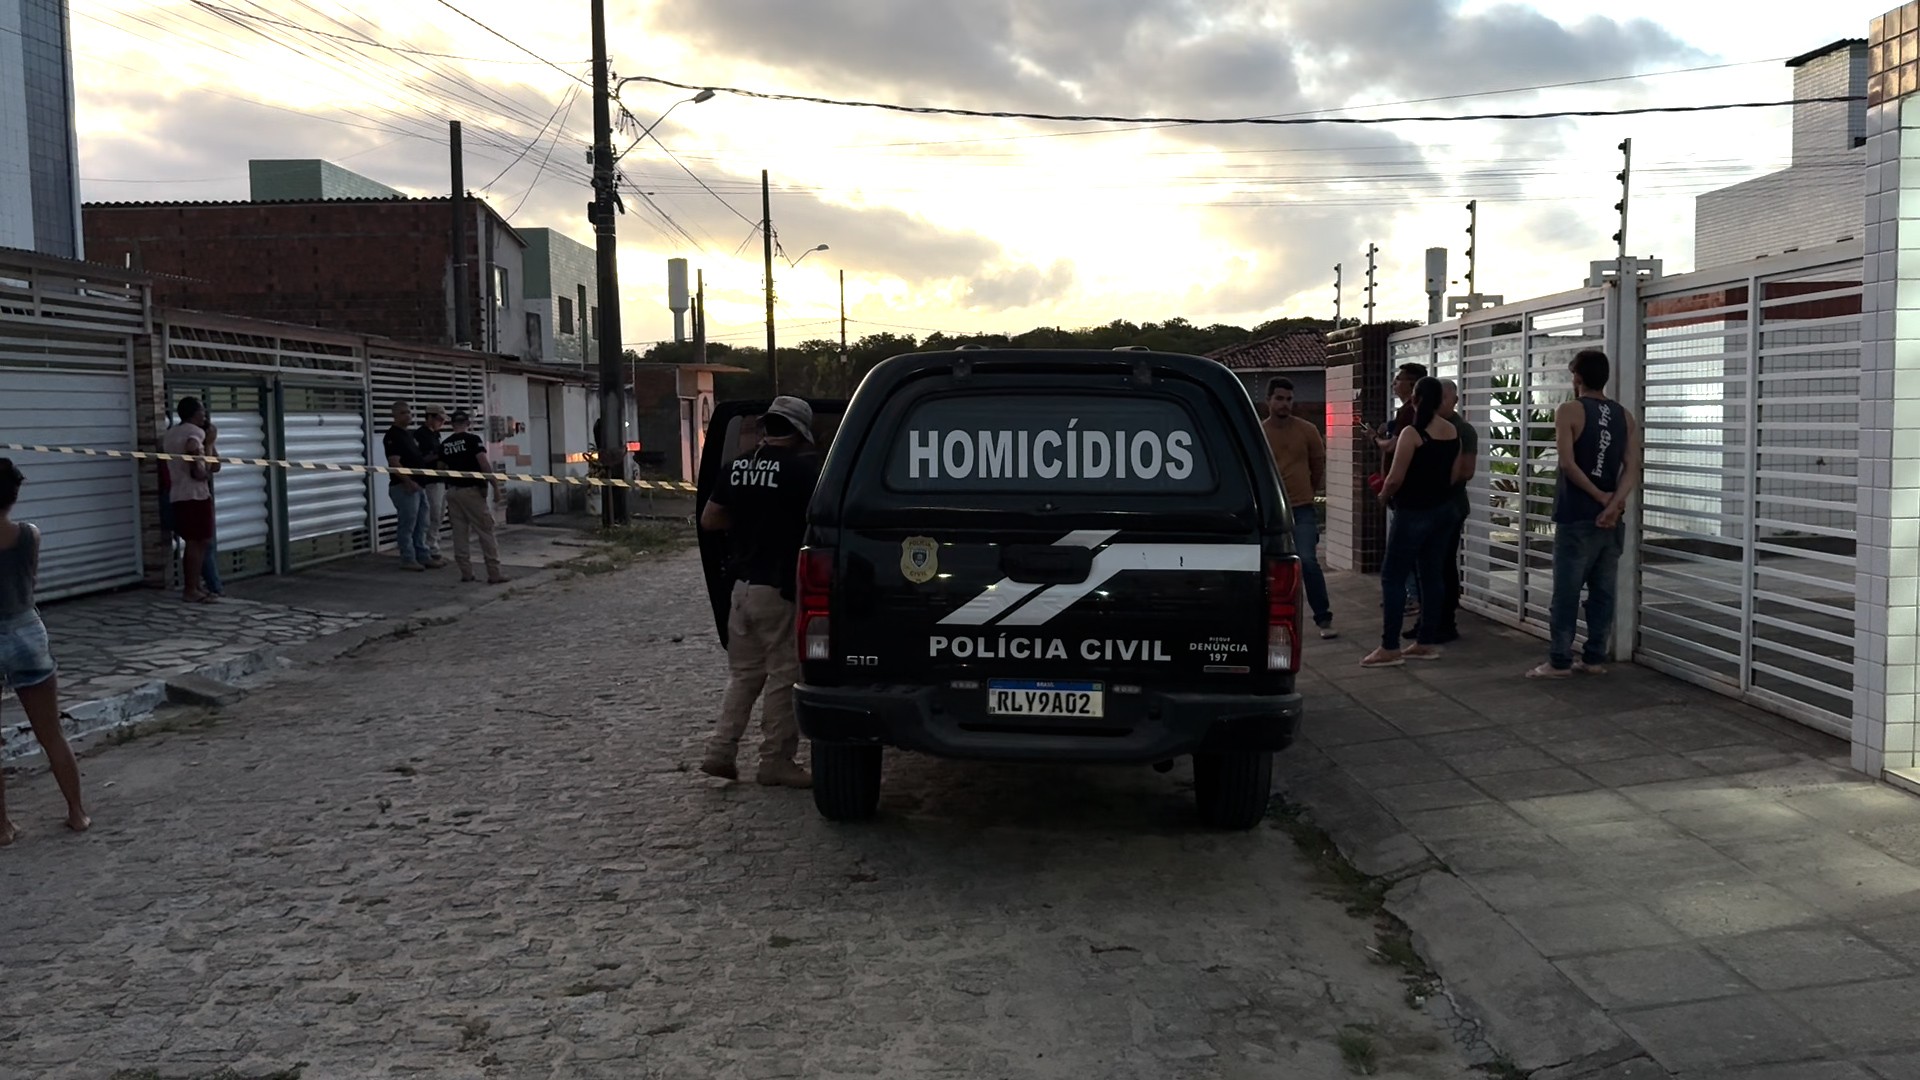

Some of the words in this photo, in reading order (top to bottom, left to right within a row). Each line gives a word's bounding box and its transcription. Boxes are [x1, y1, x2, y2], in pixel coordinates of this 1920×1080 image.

[443, 444, 467, 455] CIVIL
[909, 418, 1194, 480] HOMICÍDIOS
[730, 470, 779, 488] CIVIL
[929, 633, 1068, 660] POLÍCIA
[1080, 638, 1172, 662] CIVIL
[1189, 641, 1248, 652] DENÚNCIA
[846, 655, 879, 666] S10
[1209, 653, 1228, 662] 197
[997, 691, 1091, 714] RLY9A02
